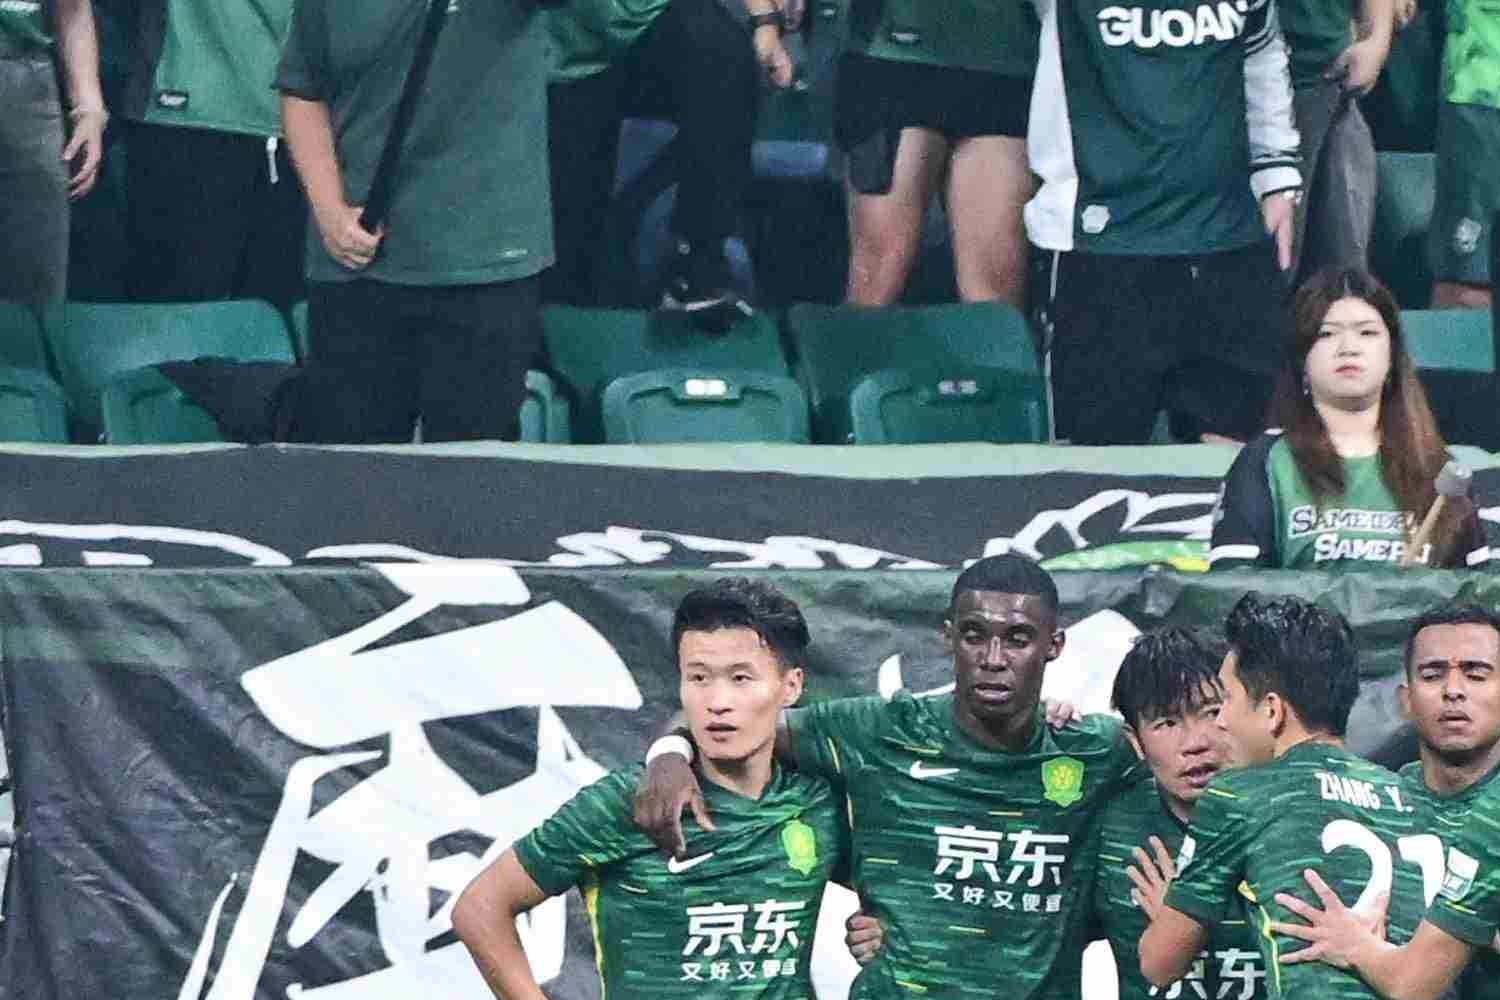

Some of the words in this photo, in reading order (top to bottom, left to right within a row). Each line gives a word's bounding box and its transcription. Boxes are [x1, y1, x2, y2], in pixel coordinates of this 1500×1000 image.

[1314, 772, 1381, 810] ZHANG
[1384, 786, 1414, 812] Y.
[933, 825, 1070, 887] 京东
[932, 883, 1063, 912] 又好又便宜
[682, 899, 806, 956] 京东
